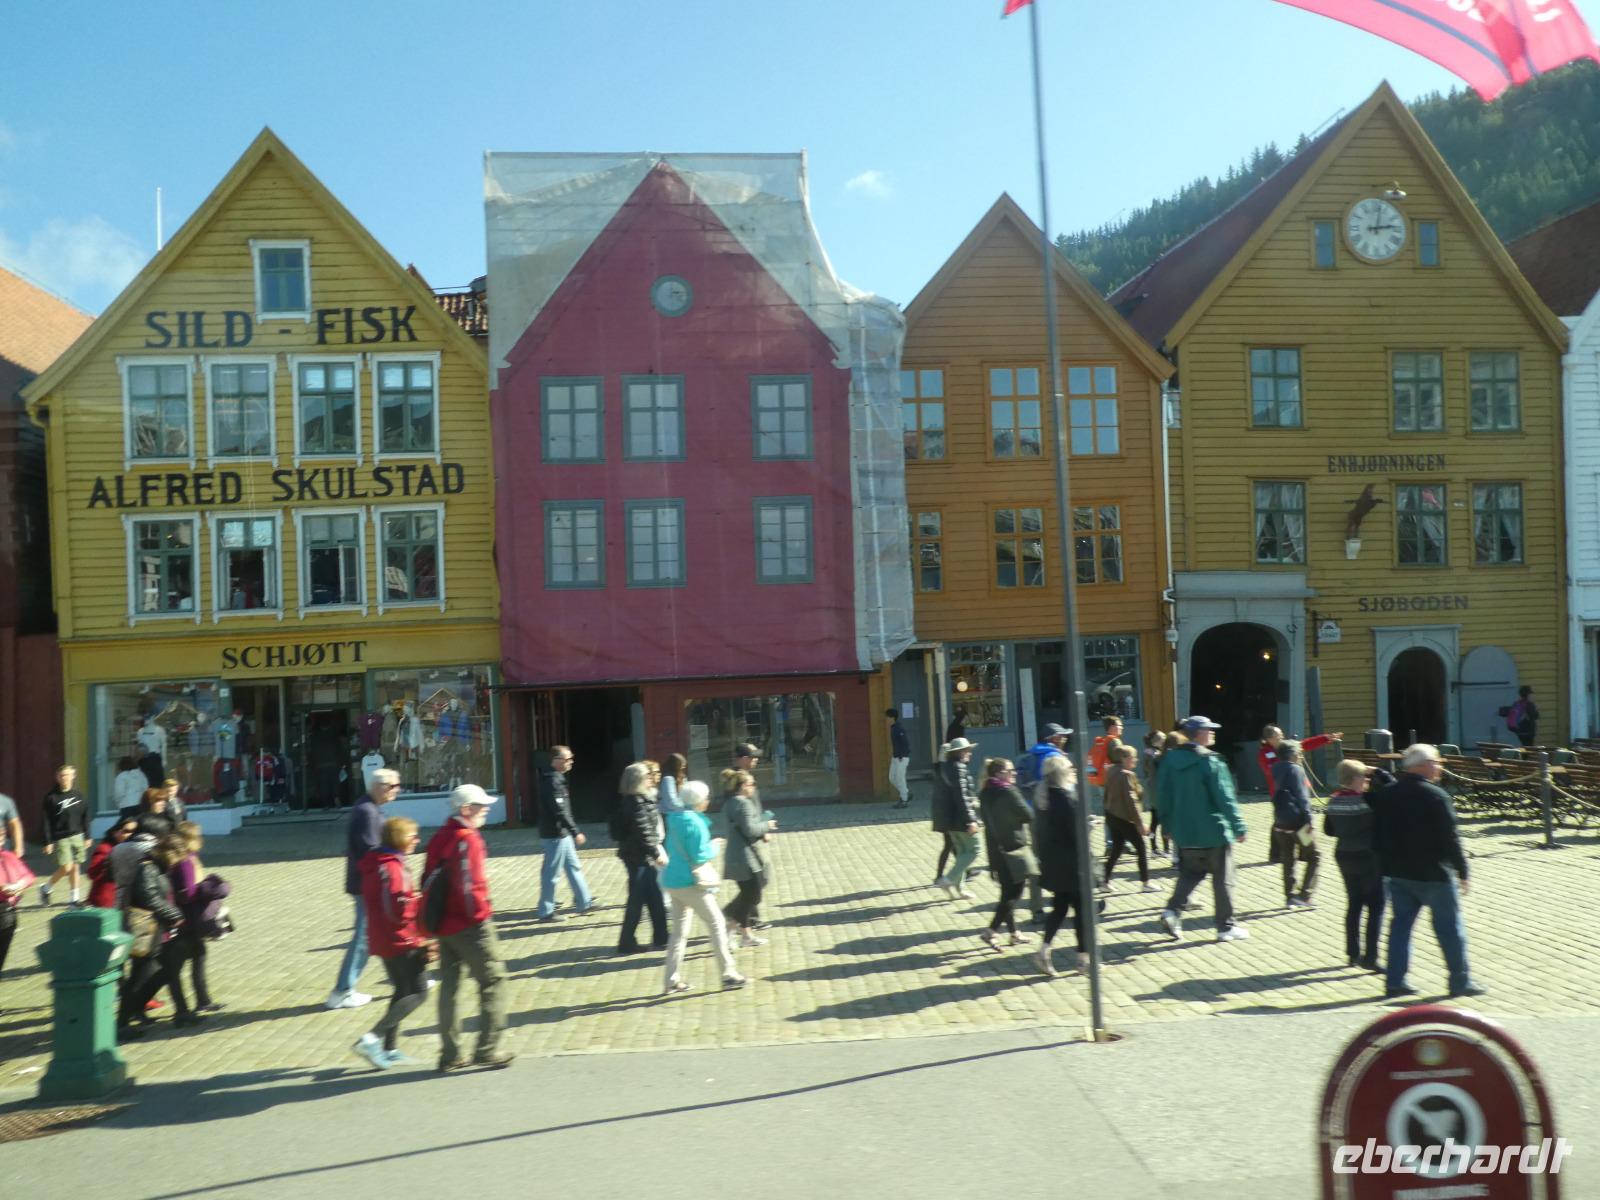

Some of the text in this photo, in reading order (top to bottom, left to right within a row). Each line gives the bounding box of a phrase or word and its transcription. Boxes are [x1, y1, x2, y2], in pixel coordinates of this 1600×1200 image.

[145, 310, 253, 348] SILD
[316, 305, 418, 345] FISK
[1328, 453, 1446, 473] ENHJØRNINGEN
[87, 463, 465, 509] ALFRED SKULSTAD
[1358, 595, 1469, 612] SJØBODEN
[222, 640, 368, 670] SCHJØTT
